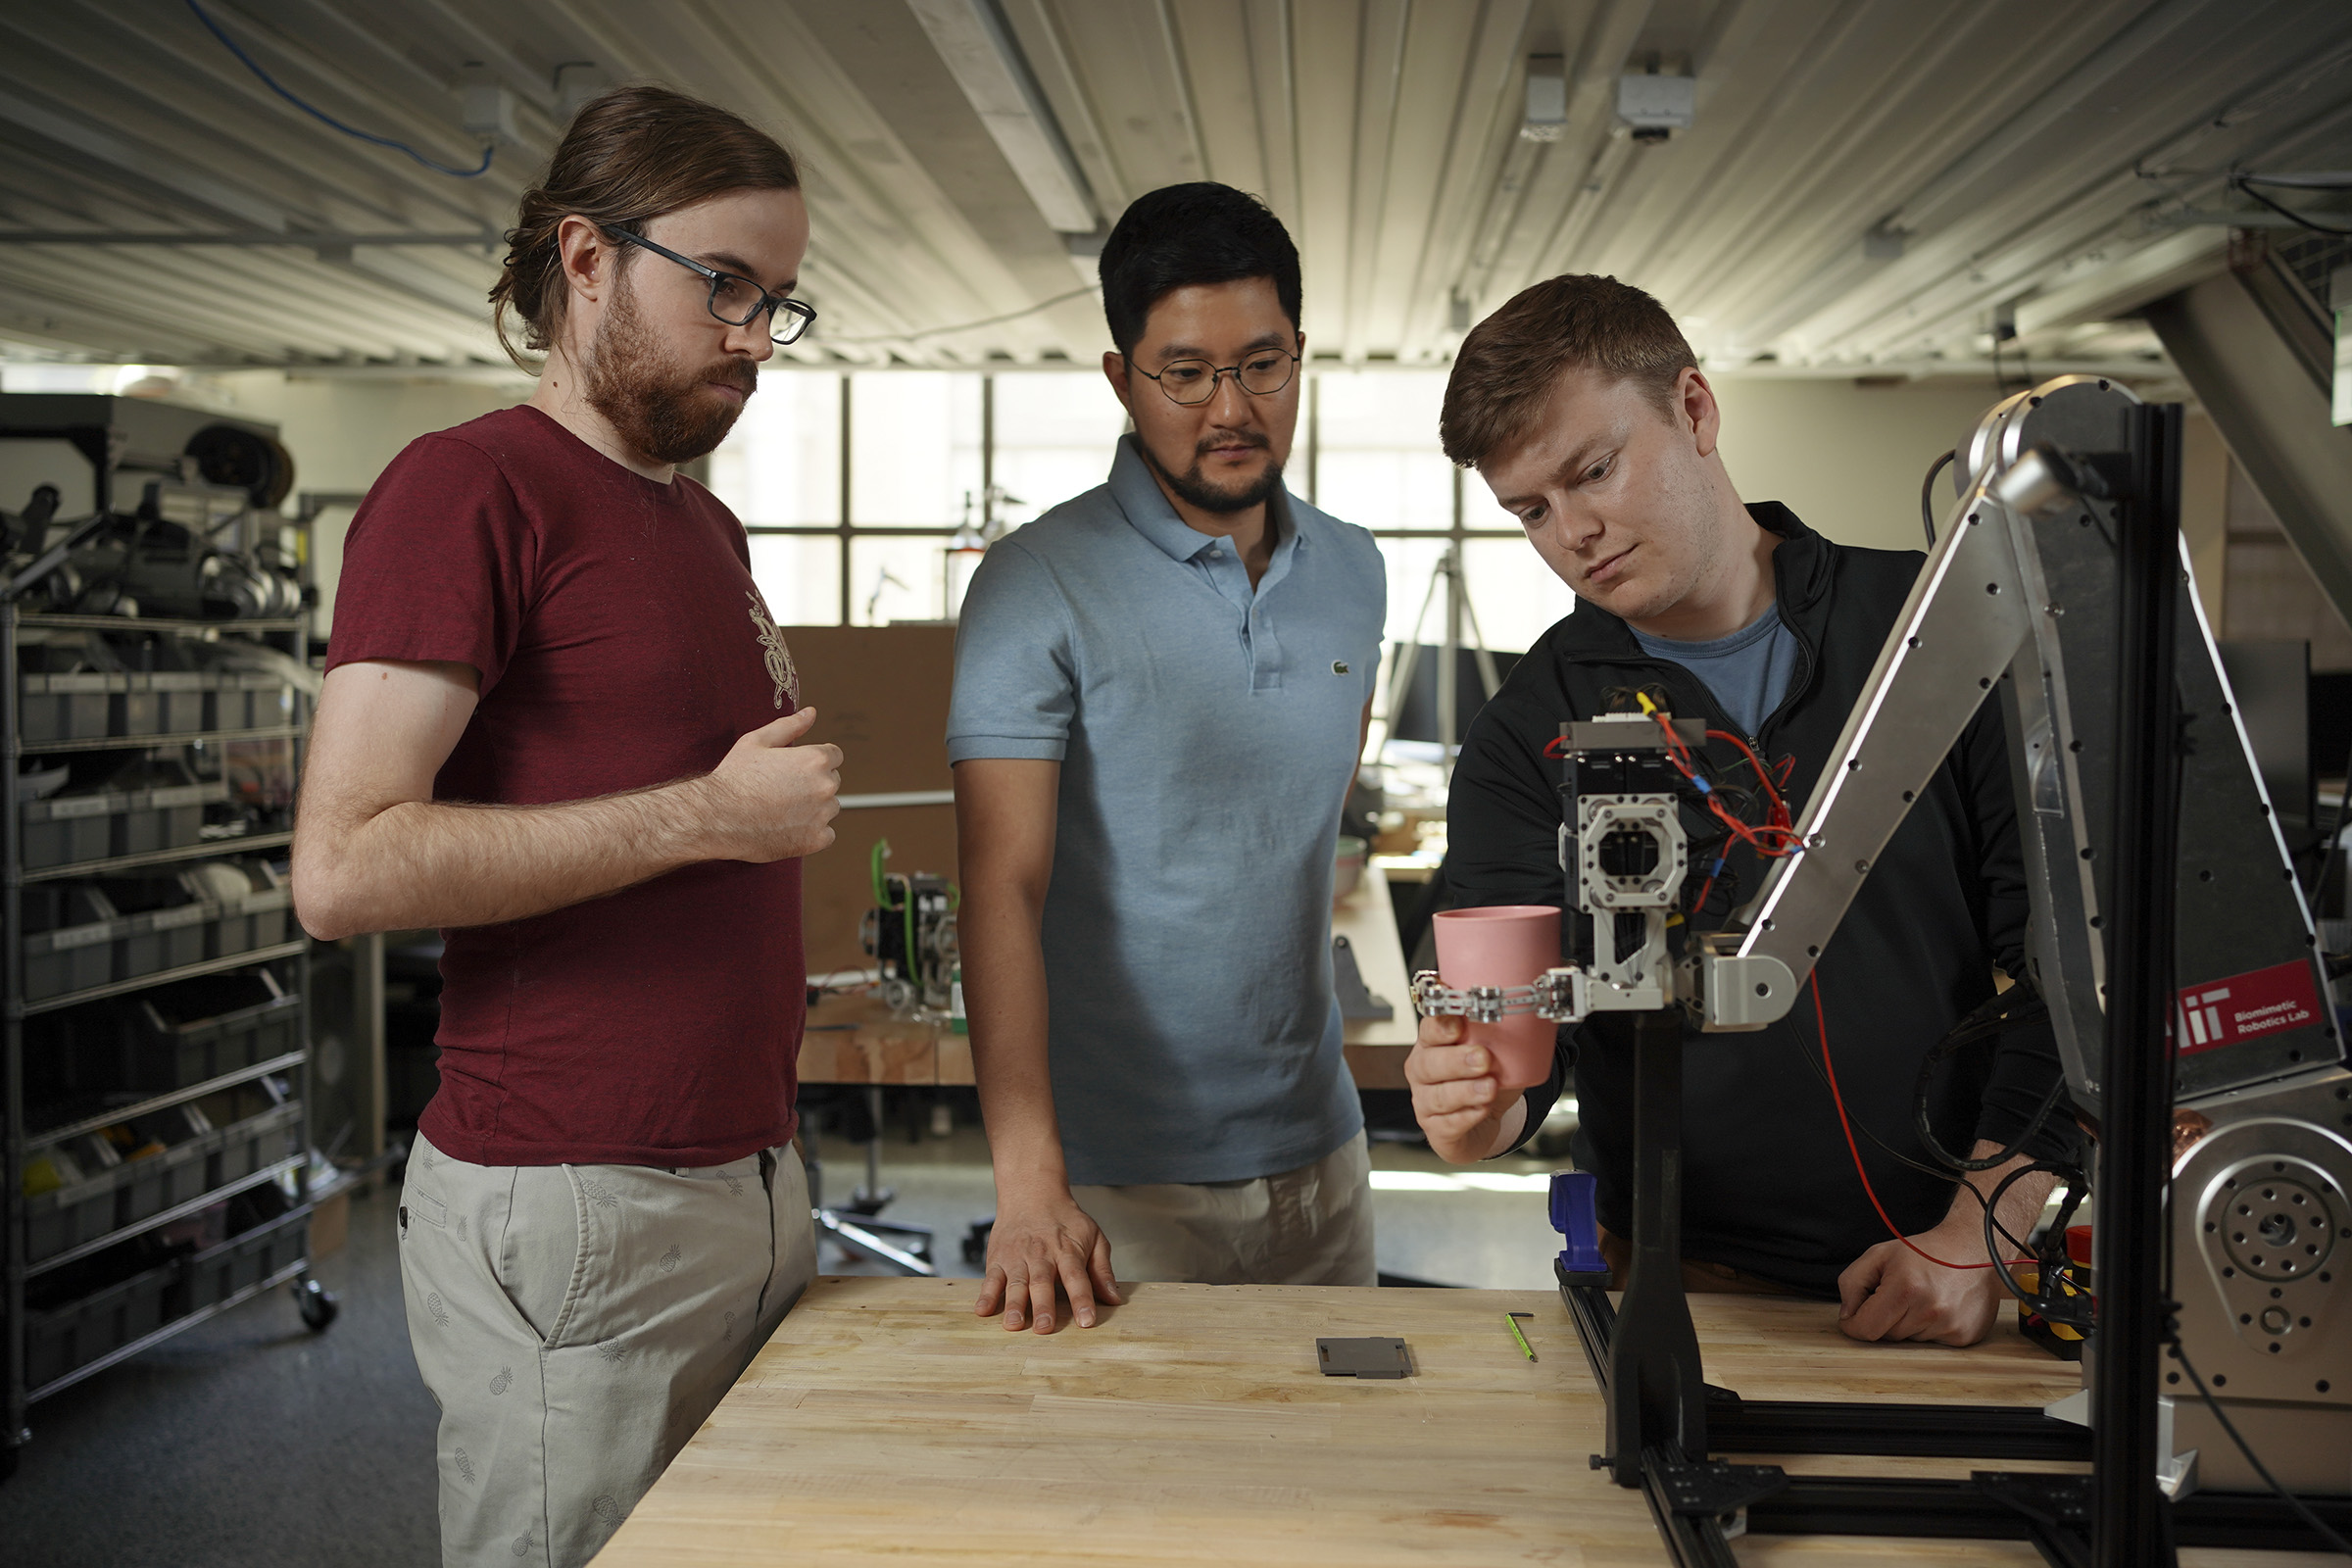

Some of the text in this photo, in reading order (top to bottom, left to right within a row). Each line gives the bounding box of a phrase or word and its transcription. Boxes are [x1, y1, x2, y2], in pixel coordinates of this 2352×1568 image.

[2234, 1001, 2296, 1022] Biomimetic
[2237, 1009, 2310, 1034] Robotics Lab
